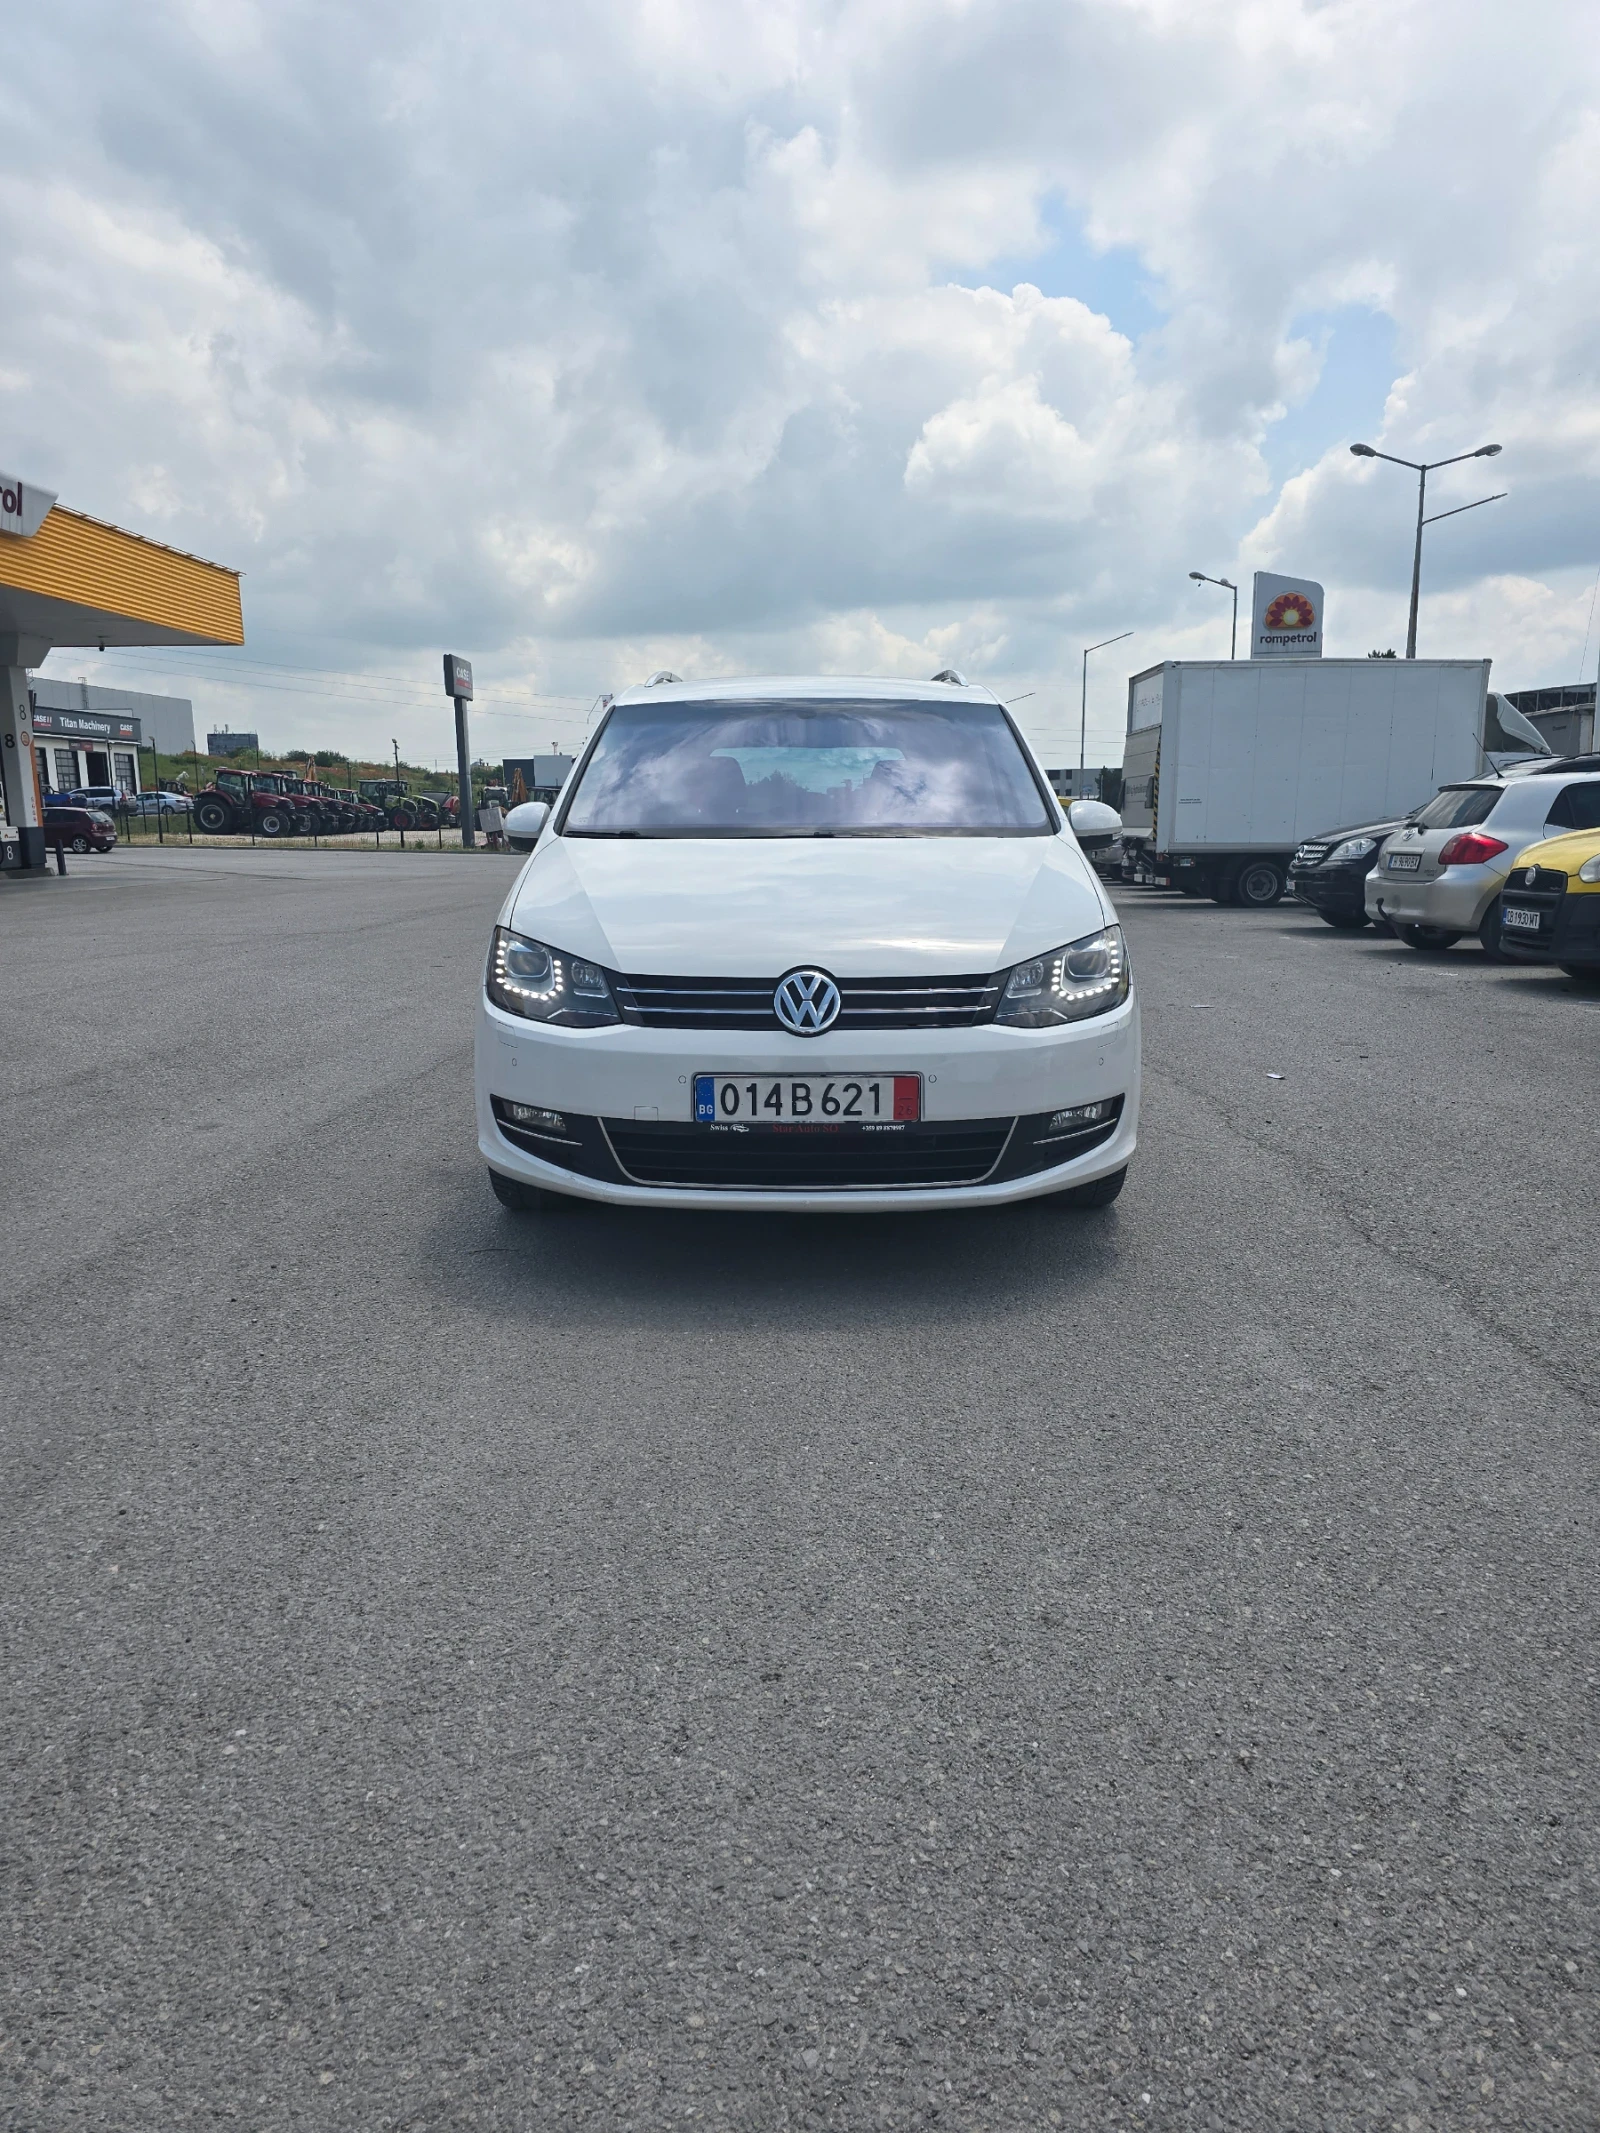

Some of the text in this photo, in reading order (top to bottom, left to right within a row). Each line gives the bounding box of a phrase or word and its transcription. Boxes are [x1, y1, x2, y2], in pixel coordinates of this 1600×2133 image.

[1260, 632, 1317, 646] rompetrol
[19, 704, 27, 720] 8
[59, 716, 111, 734] Titan Machinery
[4, 733, 15, 748] 8
[6, 845, 14, 860] 8
[699, 1104, 713, 1115] BG
[772, 1124, 793, 1133] Star
[796, 1124, 820, 1133] Auto
